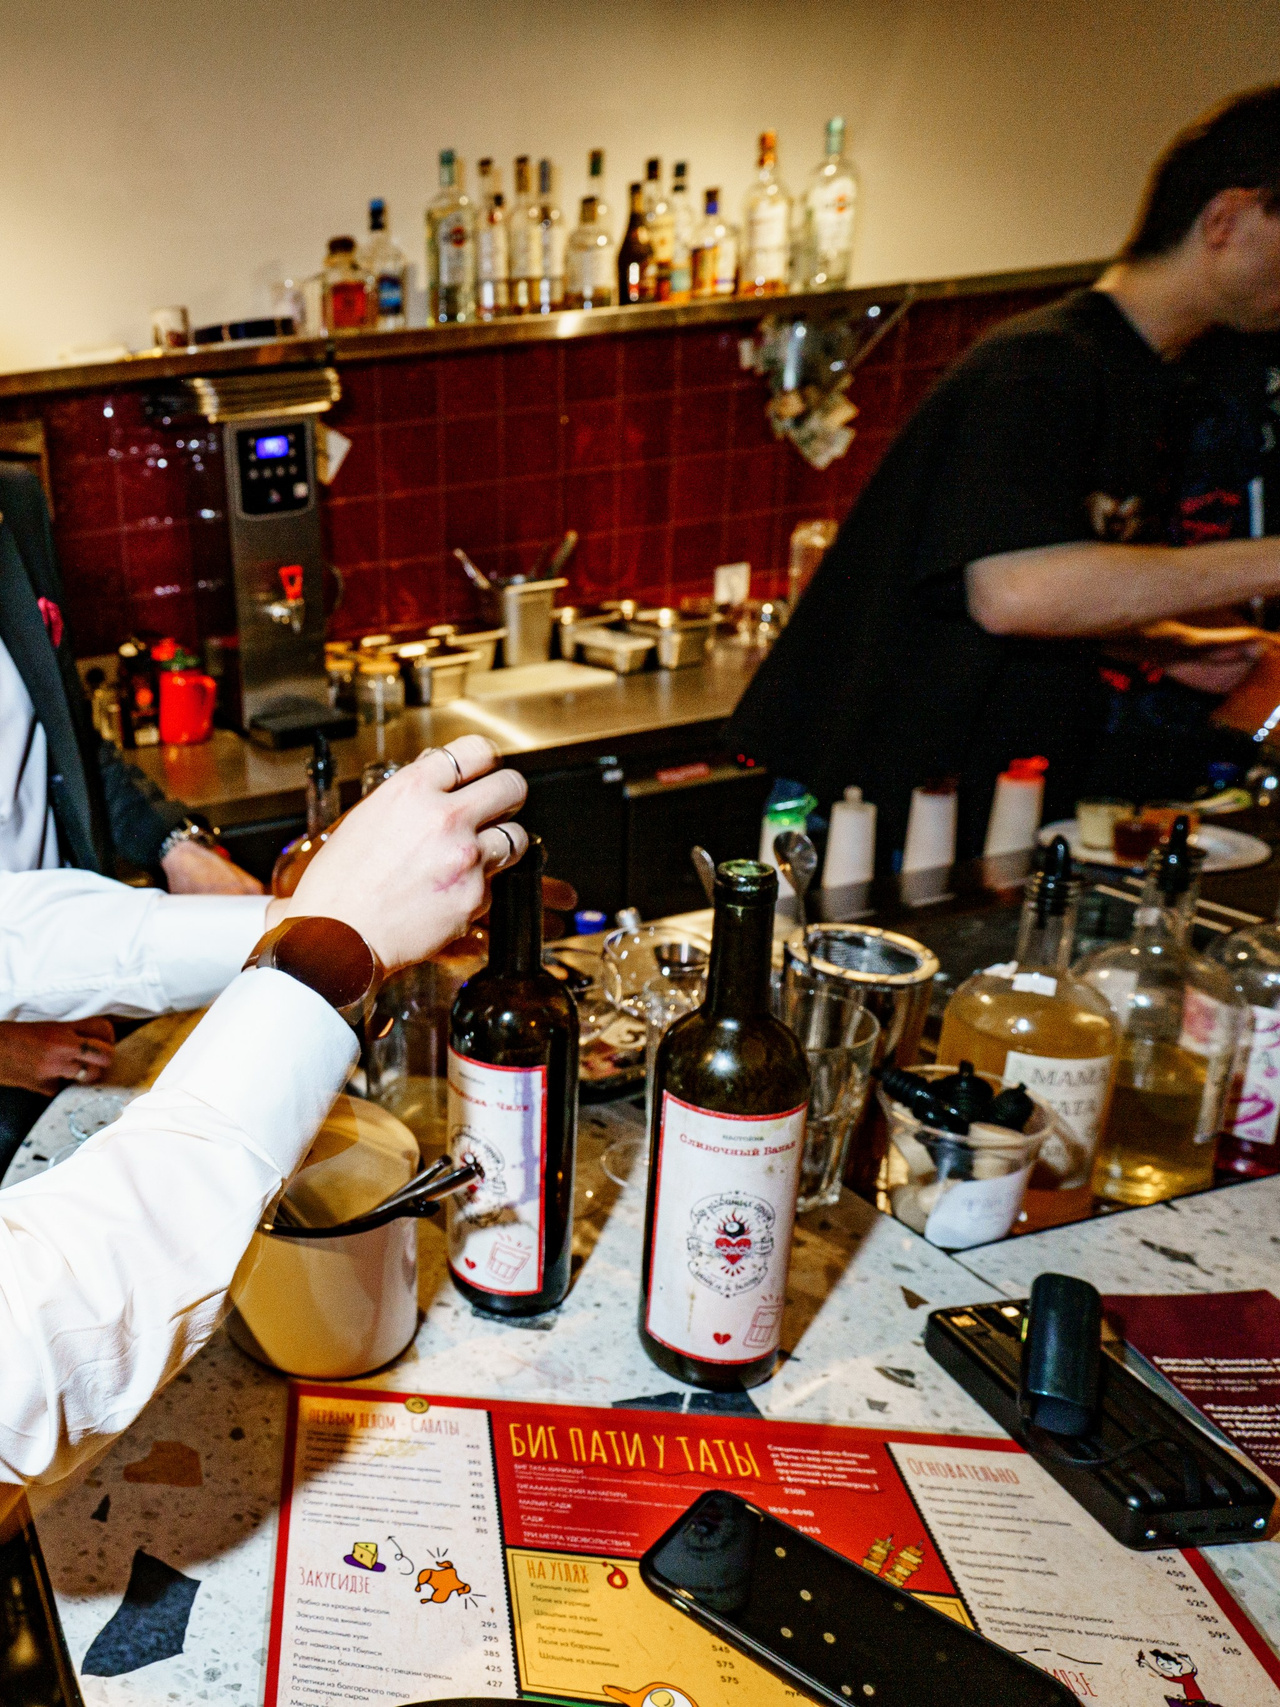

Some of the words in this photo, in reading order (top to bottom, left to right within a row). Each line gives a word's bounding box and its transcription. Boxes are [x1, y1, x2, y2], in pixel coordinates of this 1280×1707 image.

[679, 1133, 760, 1156] Сливочный
[410, 1416, 460, 1436] САЛАТЫ
[508, 1423, 558, 1460] БИГ
[569, 1427, 646, 1467] ПАТИ
[652, 1434, 665, 1470] У
[675, 1436, 761, 1477] ТАТЫ
[906, 1457, 1020, 1485] ОСНОВАТЕЛЬНО
[526, 1560, 547, 1580] НА
[550, 1561, 589, 1584] УГЛЯХ
[299, 1567, 371, 1594] ЗАКУСИДЗЕ
[1186, 1598, 1208, 1608] 525
[1196, 1613, 1219, 1624] 585
[481, 1620, 498, 1629] 295
[483, 1635, 499, 1643] 295
[1208, 1630, 1231, 1640] 595
[294, 1638, 308, 1646] Сет
[352, 1646, 383, 1656] Тбилиси
[711, 1644, 731, 1654] 545
[1222, 1646, 1242, 1656] 615
[484, 1649, 500, 1658] 385
[293, 1652, 326, 1664] Рулетики
[337, 1659, 384, 1672] баклажанов
[391, 1668, 422, 1677] грецким
[423, 1672, 453, 1681] орехом
[485, 1664, 502, 1673] 425
[716, 1659, 736, 1670] 575
[486, 1680, 503, 1688] 427
[720, 1675, 739, 1685] 575
[292, 1675, 326, 1686] Рулетики
[337, 1681, 385, 1695] болгарского
[386, 1690, 410, 1699] перца
[302, 1686, 343, 1697] сливочным
[344, 1692, 370, 1701] сыром
